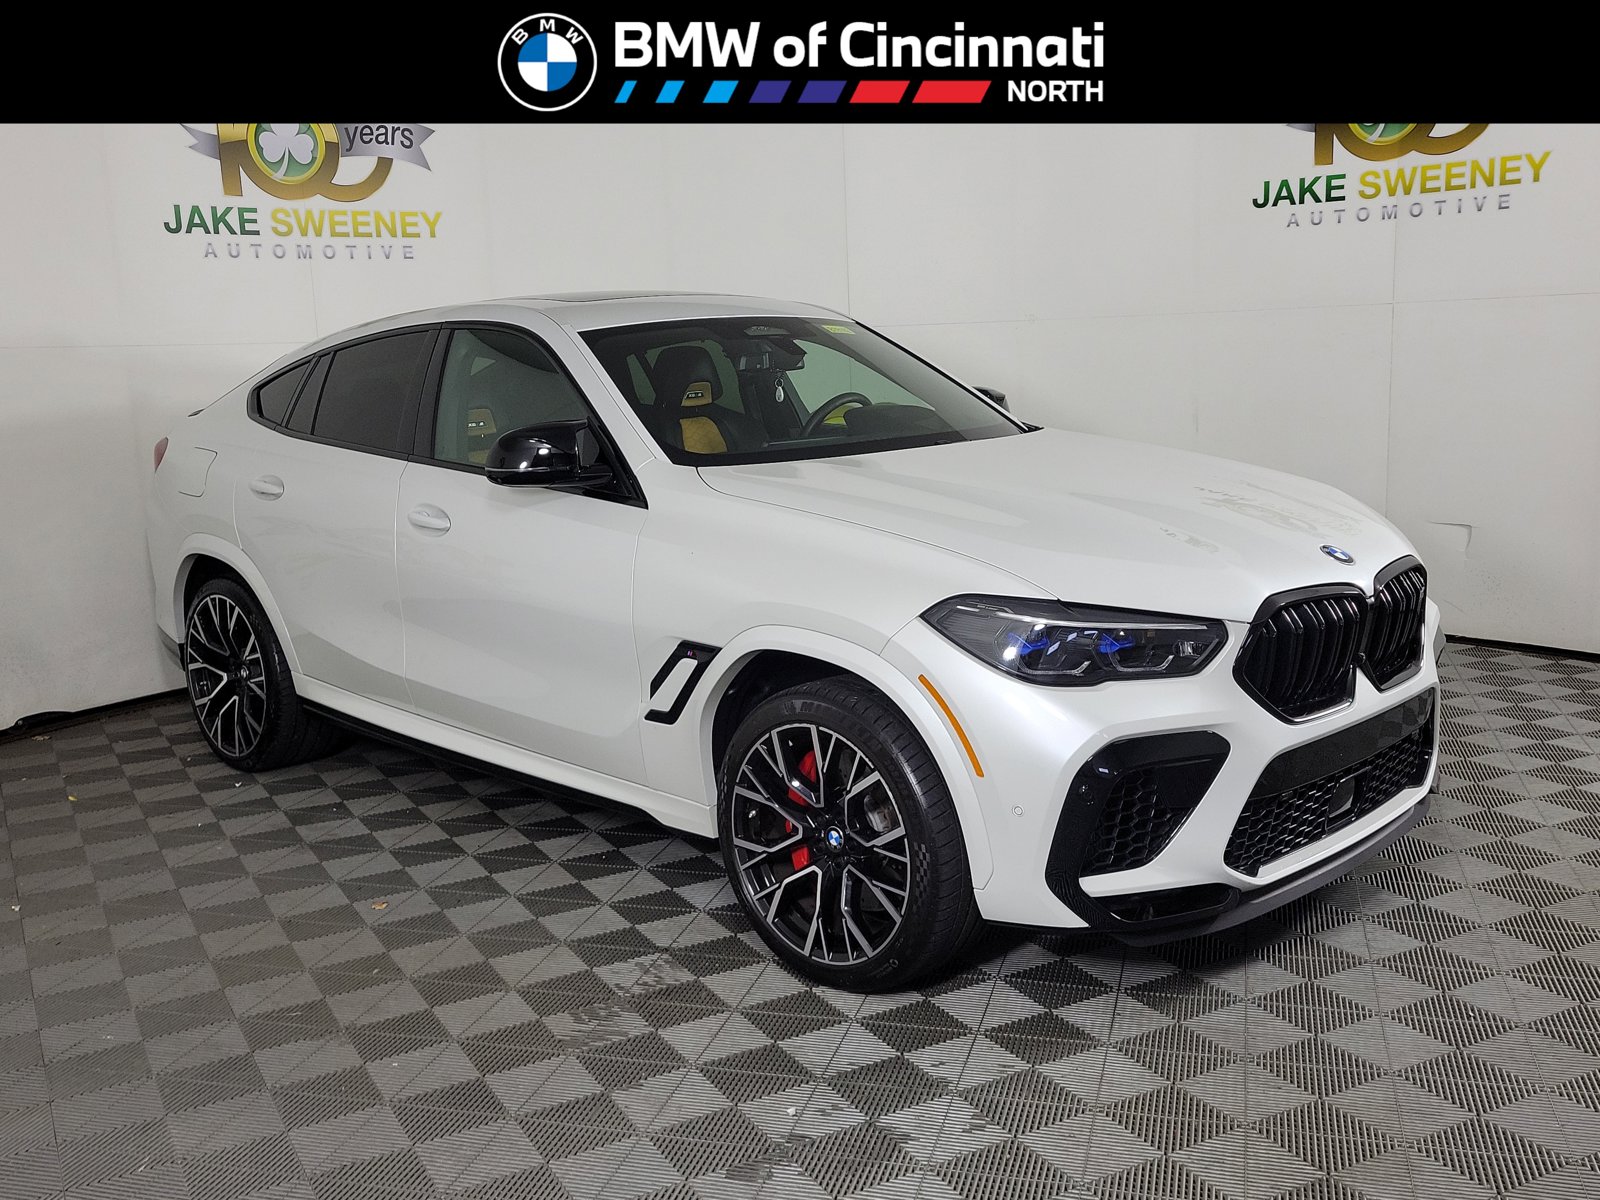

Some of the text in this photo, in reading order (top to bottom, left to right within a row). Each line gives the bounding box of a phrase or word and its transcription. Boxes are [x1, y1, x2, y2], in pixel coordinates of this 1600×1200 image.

[344, 124, 414, 152] years
[1252, 150, 1553, 208] JAKE SWEENEY
[163, 204, 443, 239] JAKE SWEENEY
[1286, 193, 1511, 228] AUTOMOTIVE
[204, 243, 415, 260] AUTOMOTIVE
